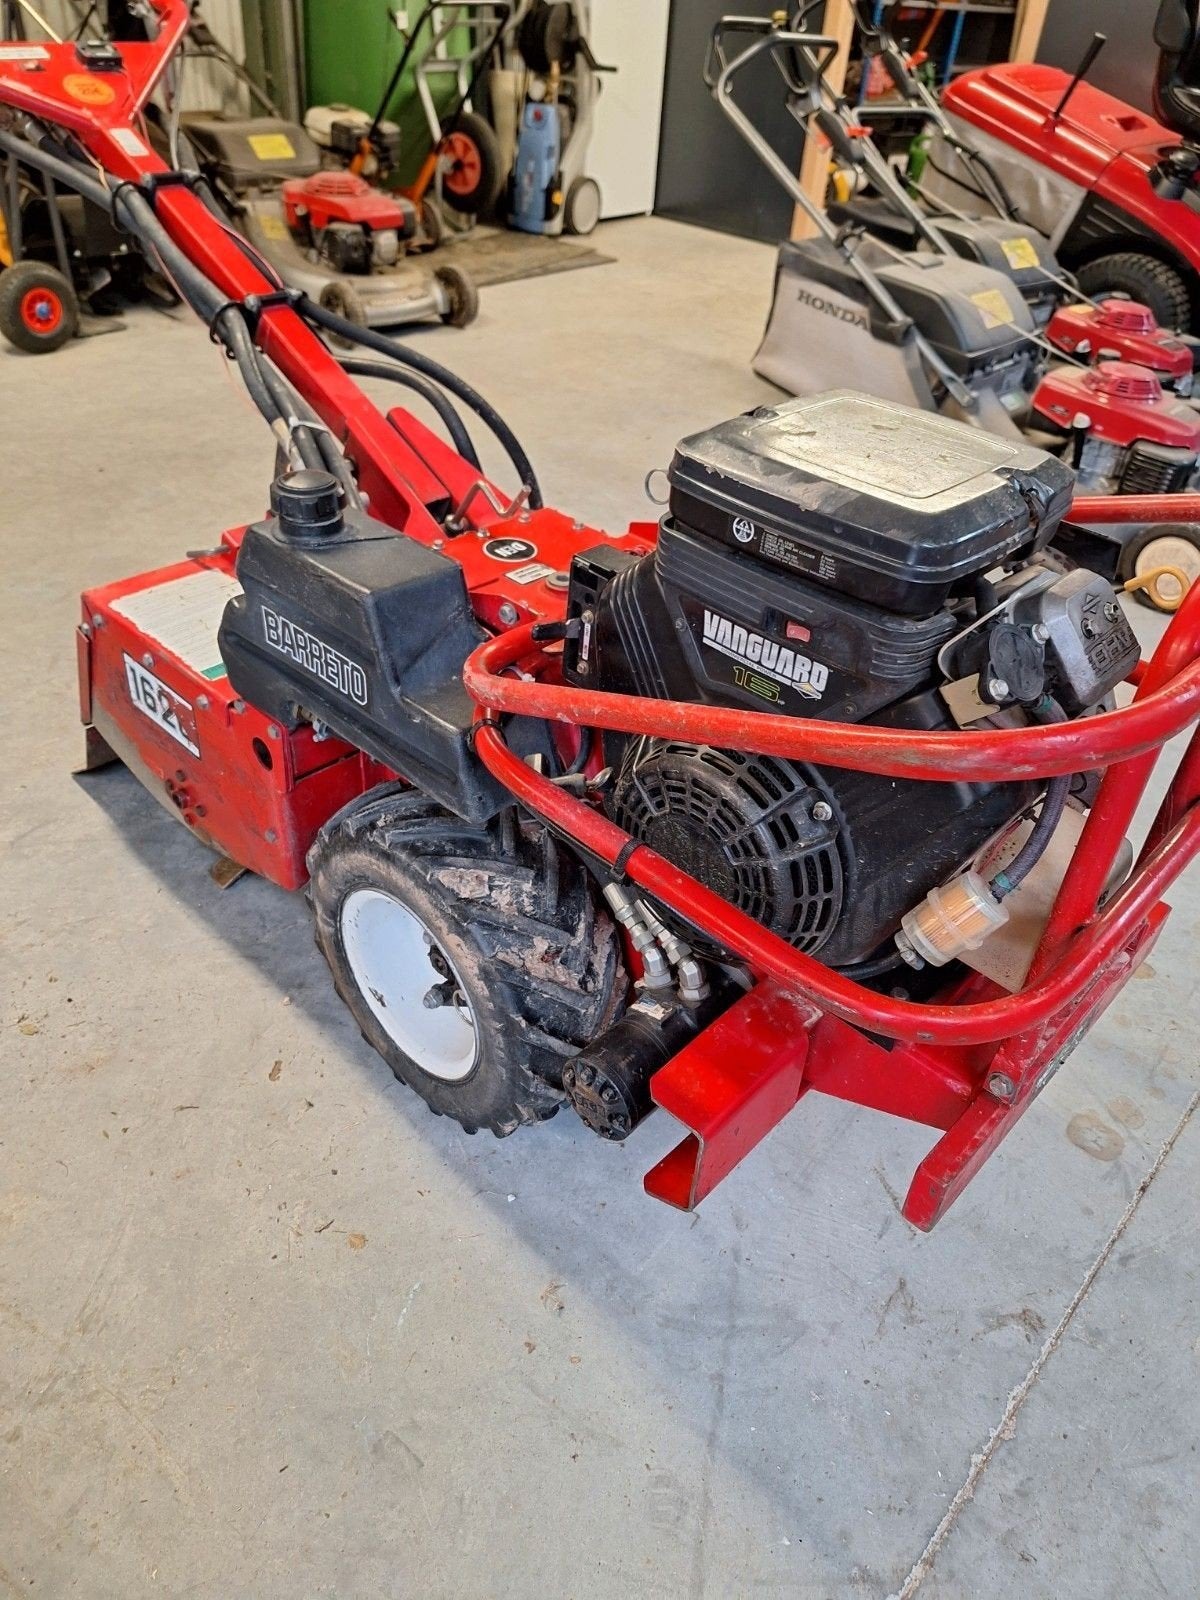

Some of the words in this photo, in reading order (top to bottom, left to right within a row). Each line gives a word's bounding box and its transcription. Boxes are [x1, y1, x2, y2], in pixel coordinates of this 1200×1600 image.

[797, 289, 868, 331] HONDA
[261, 605, 367, 705] BARRETO
[703, 609, 829, 692] VANGUARD
[733, 665, 780, 702] 16
[129, 665, 188, 742] 162
